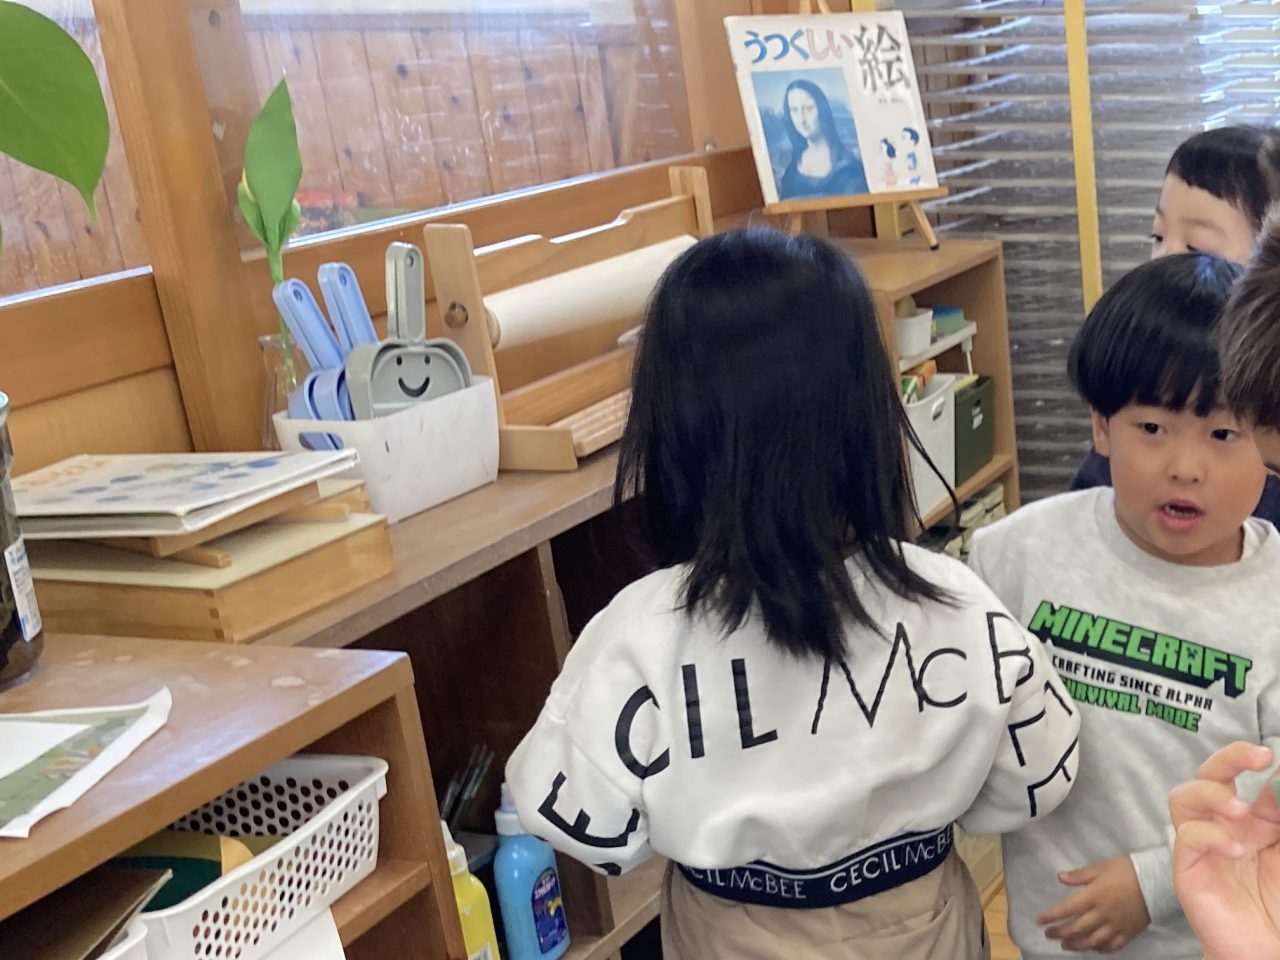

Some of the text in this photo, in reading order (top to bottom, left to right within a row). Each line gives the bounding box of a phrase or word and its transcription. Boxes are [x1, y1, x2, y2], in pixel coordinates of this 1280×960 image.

[744, 23, 911, 93] うつくしい絵
[1028, 600, 1252, 698] MINECRAFT
[1052, 655, 1213, 711] CRAFTING SINCE ALPHA
[1145, 698, 1201, 732] MODE
[830, 849, 901, 892] CECIL
